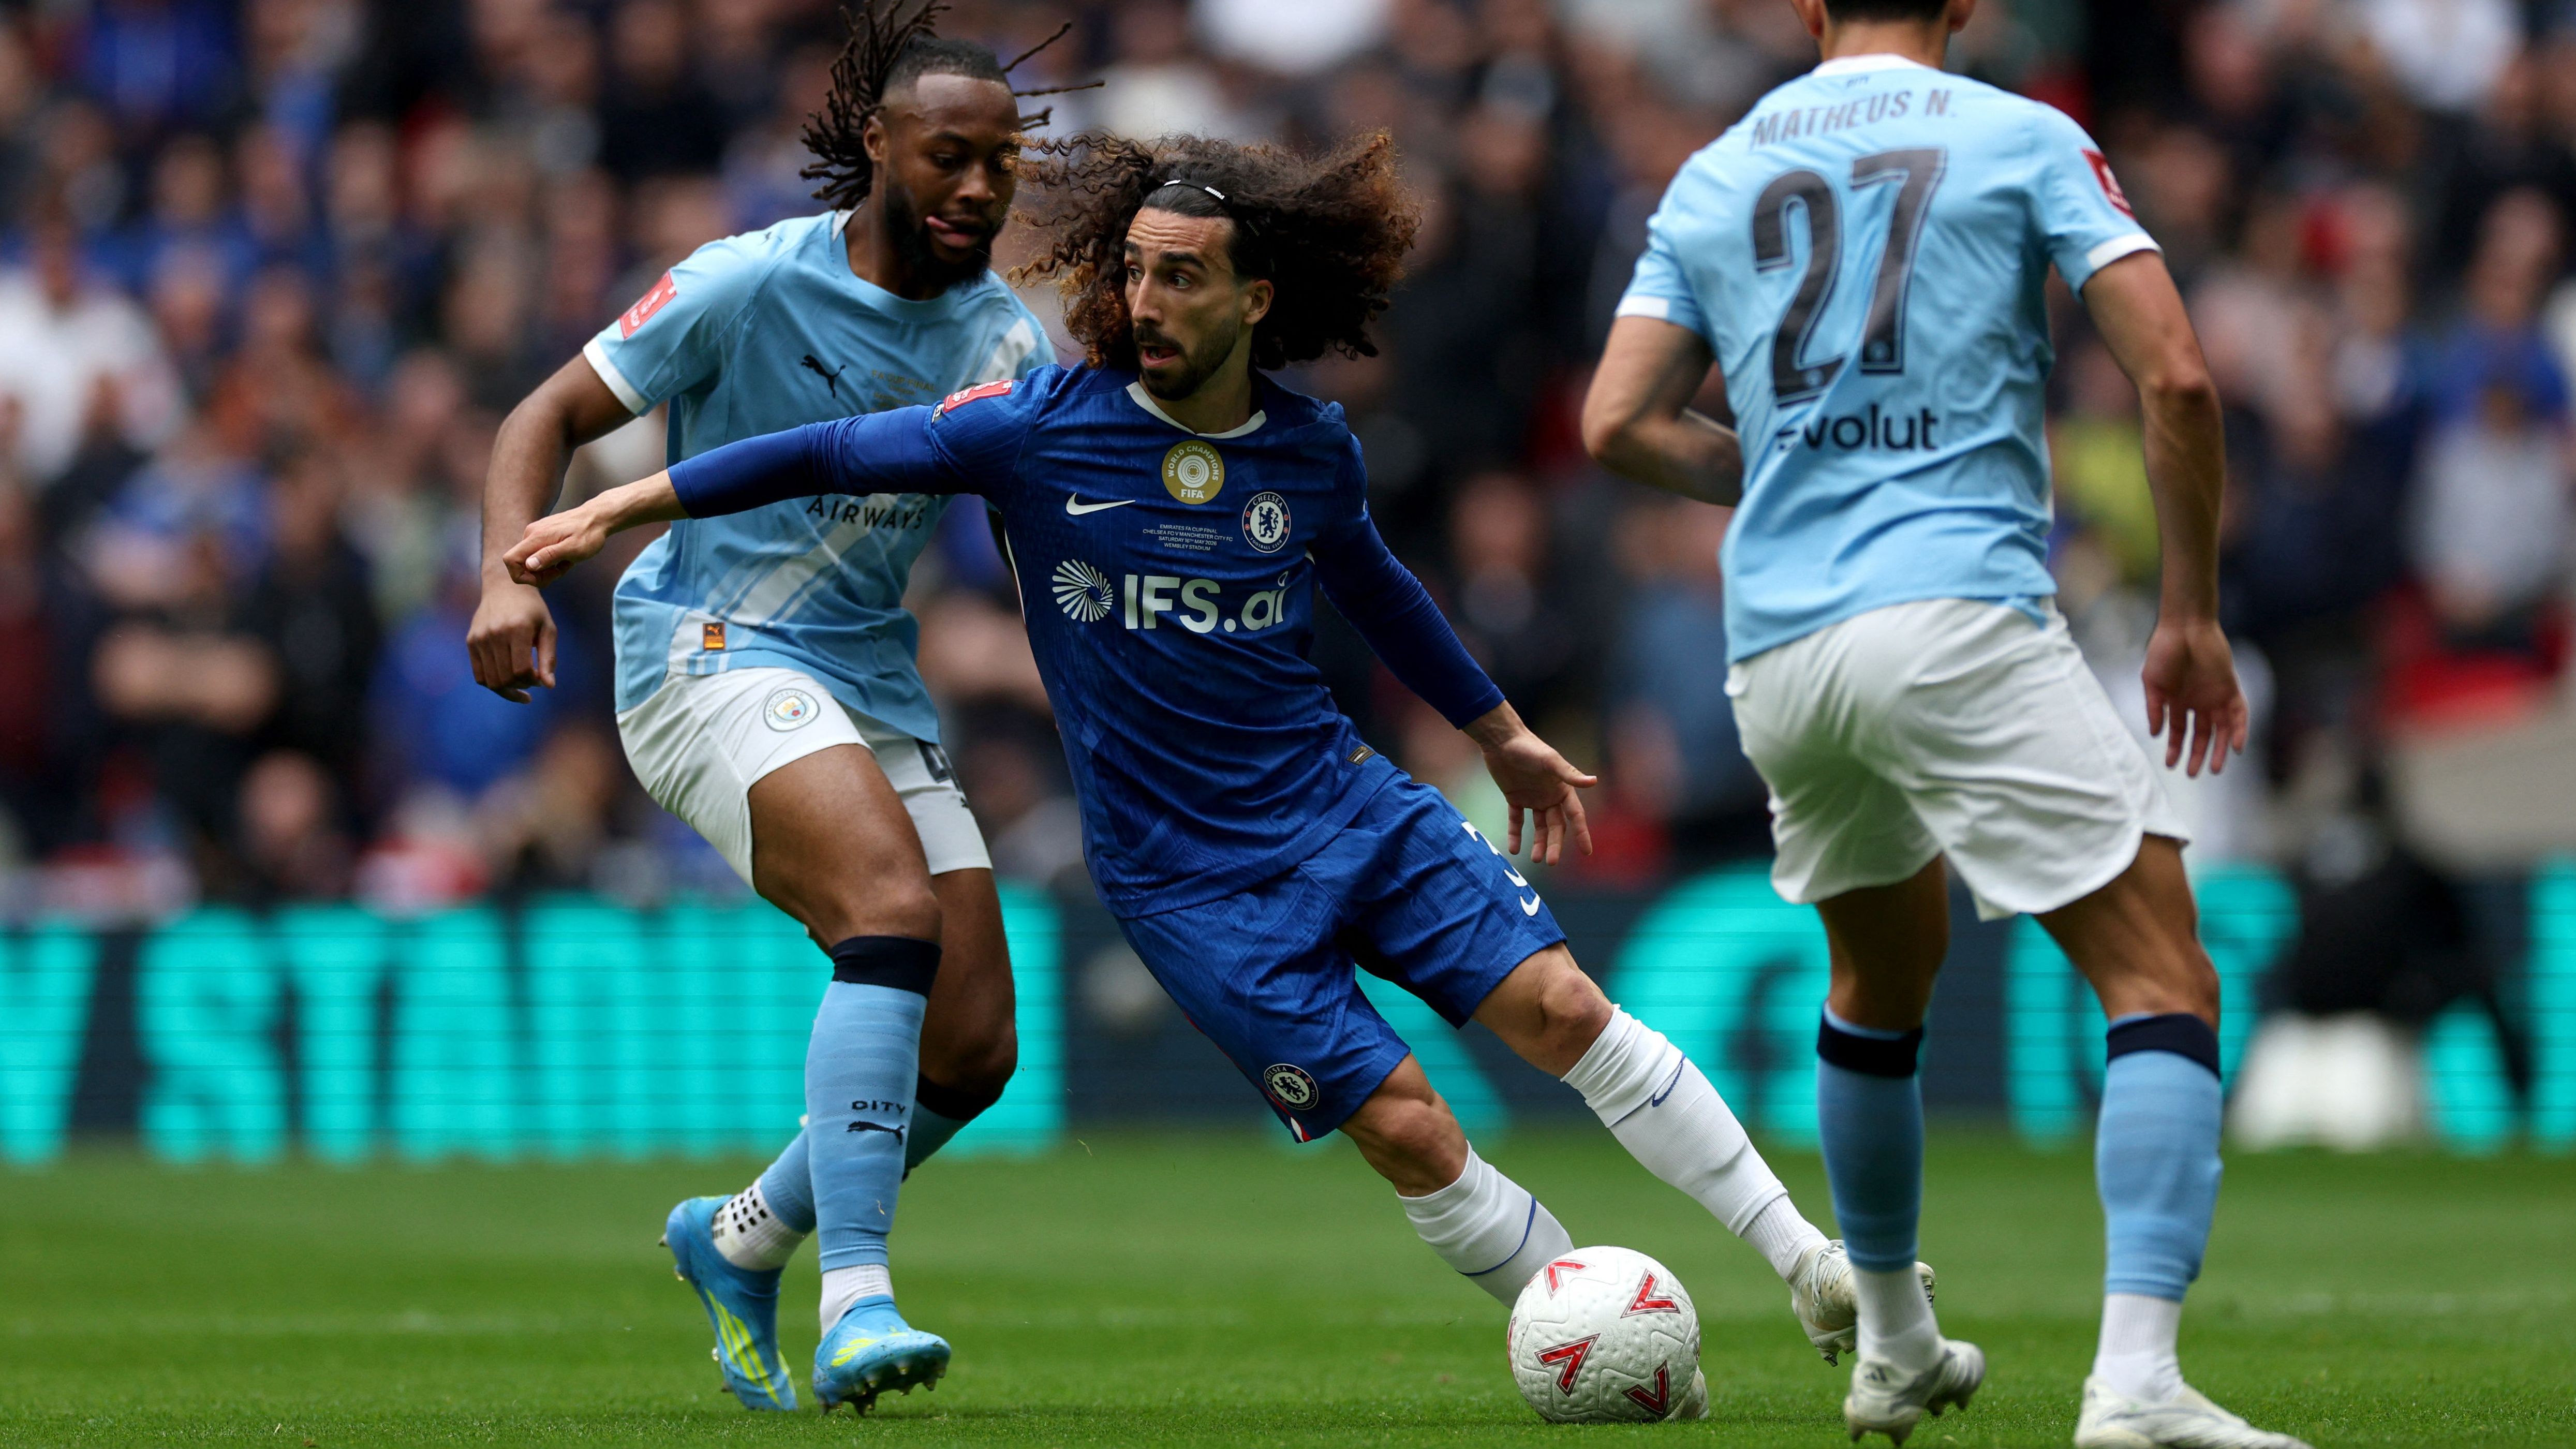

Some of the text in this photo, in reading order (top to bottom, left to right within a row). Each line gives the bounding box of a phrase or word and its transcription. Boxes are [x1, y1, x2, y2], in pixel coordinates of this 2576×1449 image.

[1751, 89, 1957, 149] MATHEUS N.
[1752, 147, 1948, 409] 27
[1775, 404, 1938, 451] volut
[1168, 446, 1219, 481] WORLD CHAMPIONS
[1181, 489, 1204, 499] FIFA
[1253, 494, 1283, 508] CHELSEA
[806, 496, 925, 529] AIRWAYS
[1250, 537, 1270, 550] FOOTBALL
[1125, 571, 1289, 633] IFS.ai
[1266, 1066, 1287, 1085] CHELSEA
